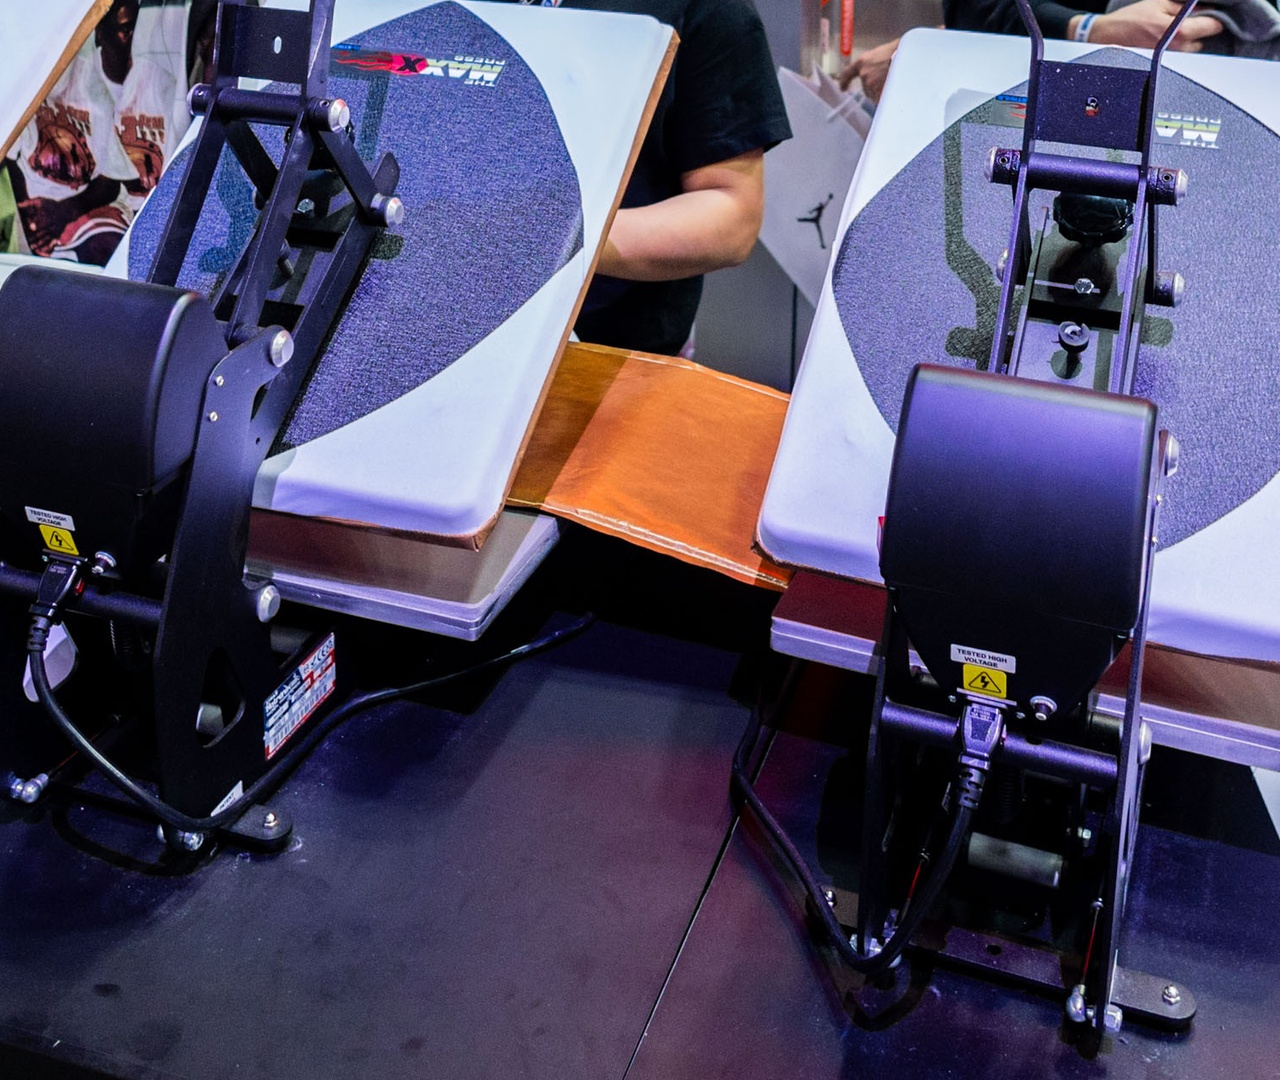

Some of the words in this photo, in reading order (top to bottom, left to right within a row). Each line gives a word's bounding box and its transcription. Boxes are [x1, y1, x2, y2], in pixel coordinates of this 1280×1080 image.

[453, 54, 507, 66] PRESS
[463, 78, 496, 88] THE
[1179, 139, 1220, 150] THE
[956, 647, 987, 660] TESTED
[987, 654, 1008, 664] HIGH
[963, 656, 999, 668] VOLTAGE
